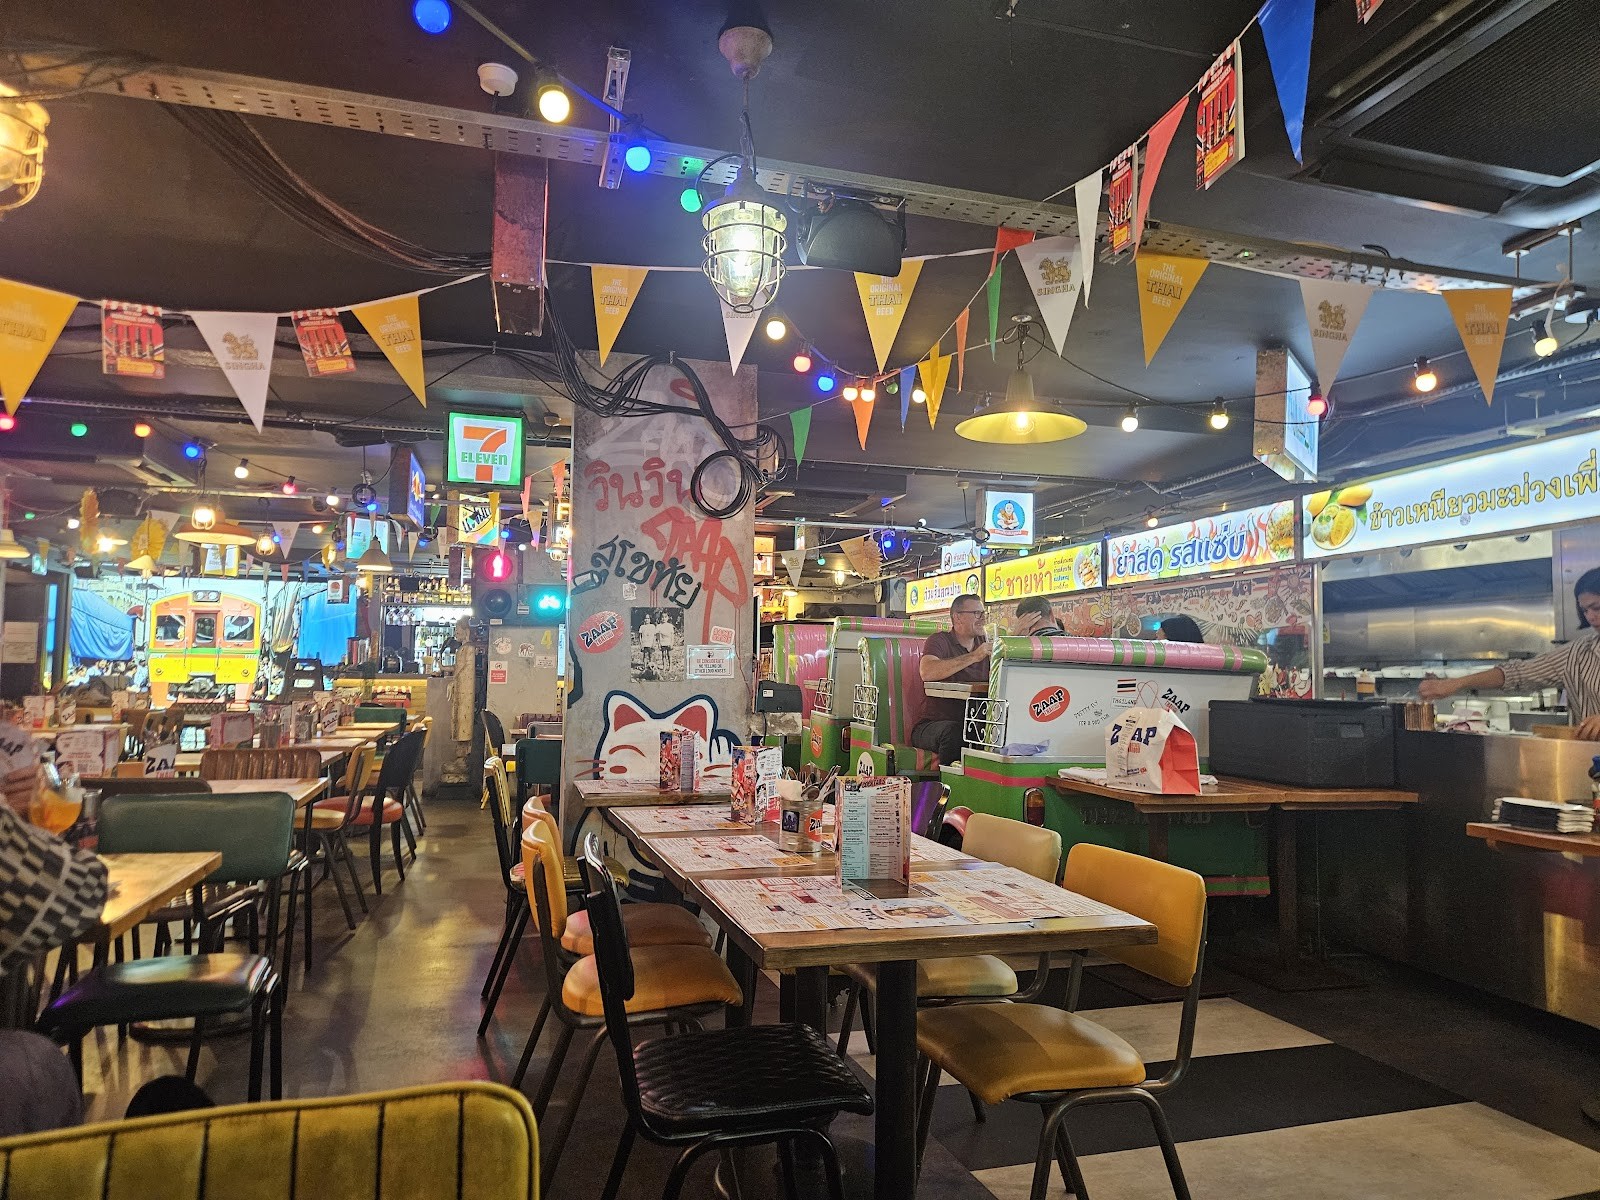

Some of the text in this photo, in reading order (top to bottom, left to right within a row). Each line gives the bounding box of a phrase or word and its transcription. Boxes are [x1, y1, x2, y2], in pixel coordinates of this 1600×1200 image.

[1163, 263, 1176, 272] THE
[1150, 268, 1183, 285] ORIGINAL
[870, 284, 902, 293] ORIGINAL
[1037, 284, 1076, 297] SINGHA
[1147, 280, 1182, 299] THAI
[600, 294, 628, 306] THAI
[869, 294, 902, 306] THAI
[1152, 295, 1171, 308] BEER
[876, 307, 895, 316] BEER
[381, 329, 415, 347] THAI
[1313, 328, 1348, 341] SINGHA
[225, 361, 266, 371] SINGHA
[462, 425, 508, 483] 7
[1116, 545, 1164, 577] ยำสด
[1182, 586, 1207, 602] ZAAP
[579, 615, 618, 649] ZAAP
[1032, 689, 1065, 717] ZAAP
[1161, 687, 1191, 713] ZAAP
[1110, 724, 1157, 746] ZAP
[144, 756, 175, 776] ZA
[859, 761, 874, 777] ZAAP
[860, 777, 887, 789] COCKTAILS
[809, 817, 822, 832] ZA
